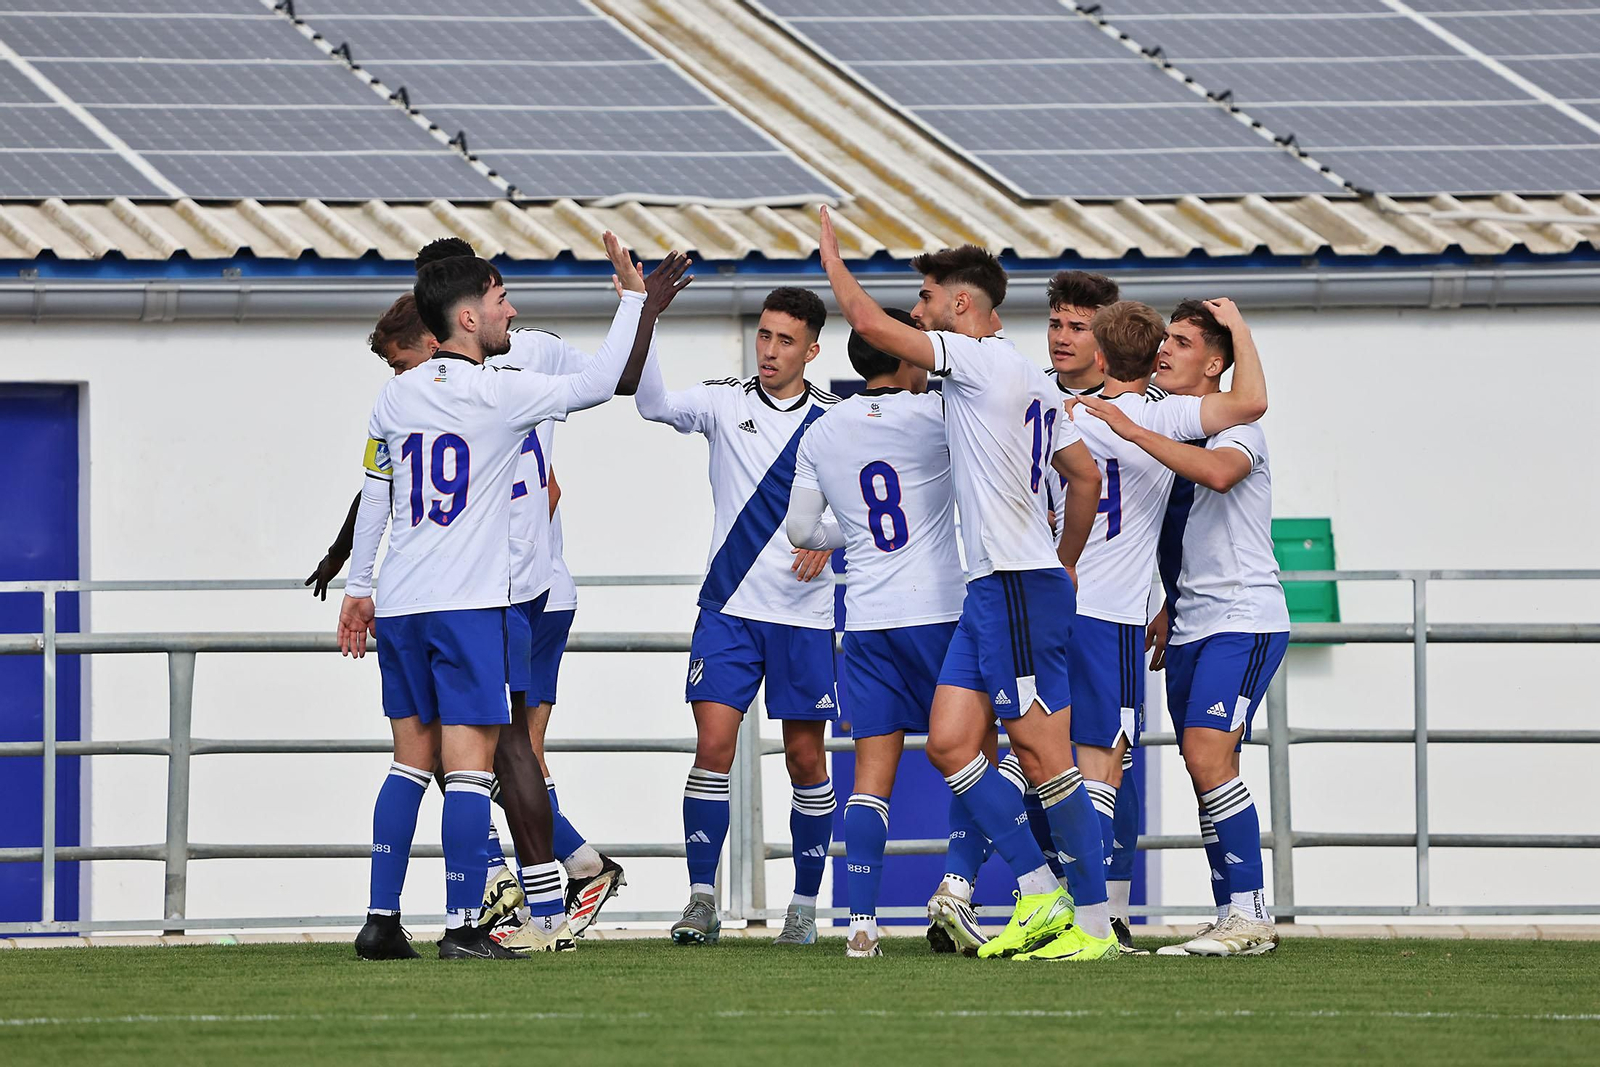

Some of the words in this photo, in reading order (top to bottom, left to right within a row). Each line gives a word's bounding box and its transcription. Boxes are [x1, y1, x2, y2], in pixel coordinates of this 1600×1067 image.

[401, 432, 470, 527] 19
[510, 427, 548, 501] 1
[859, 460, 909, 553] 8
[815, 701, 835, 709] adidas
[1206, 708, 1228, 718] adidas
